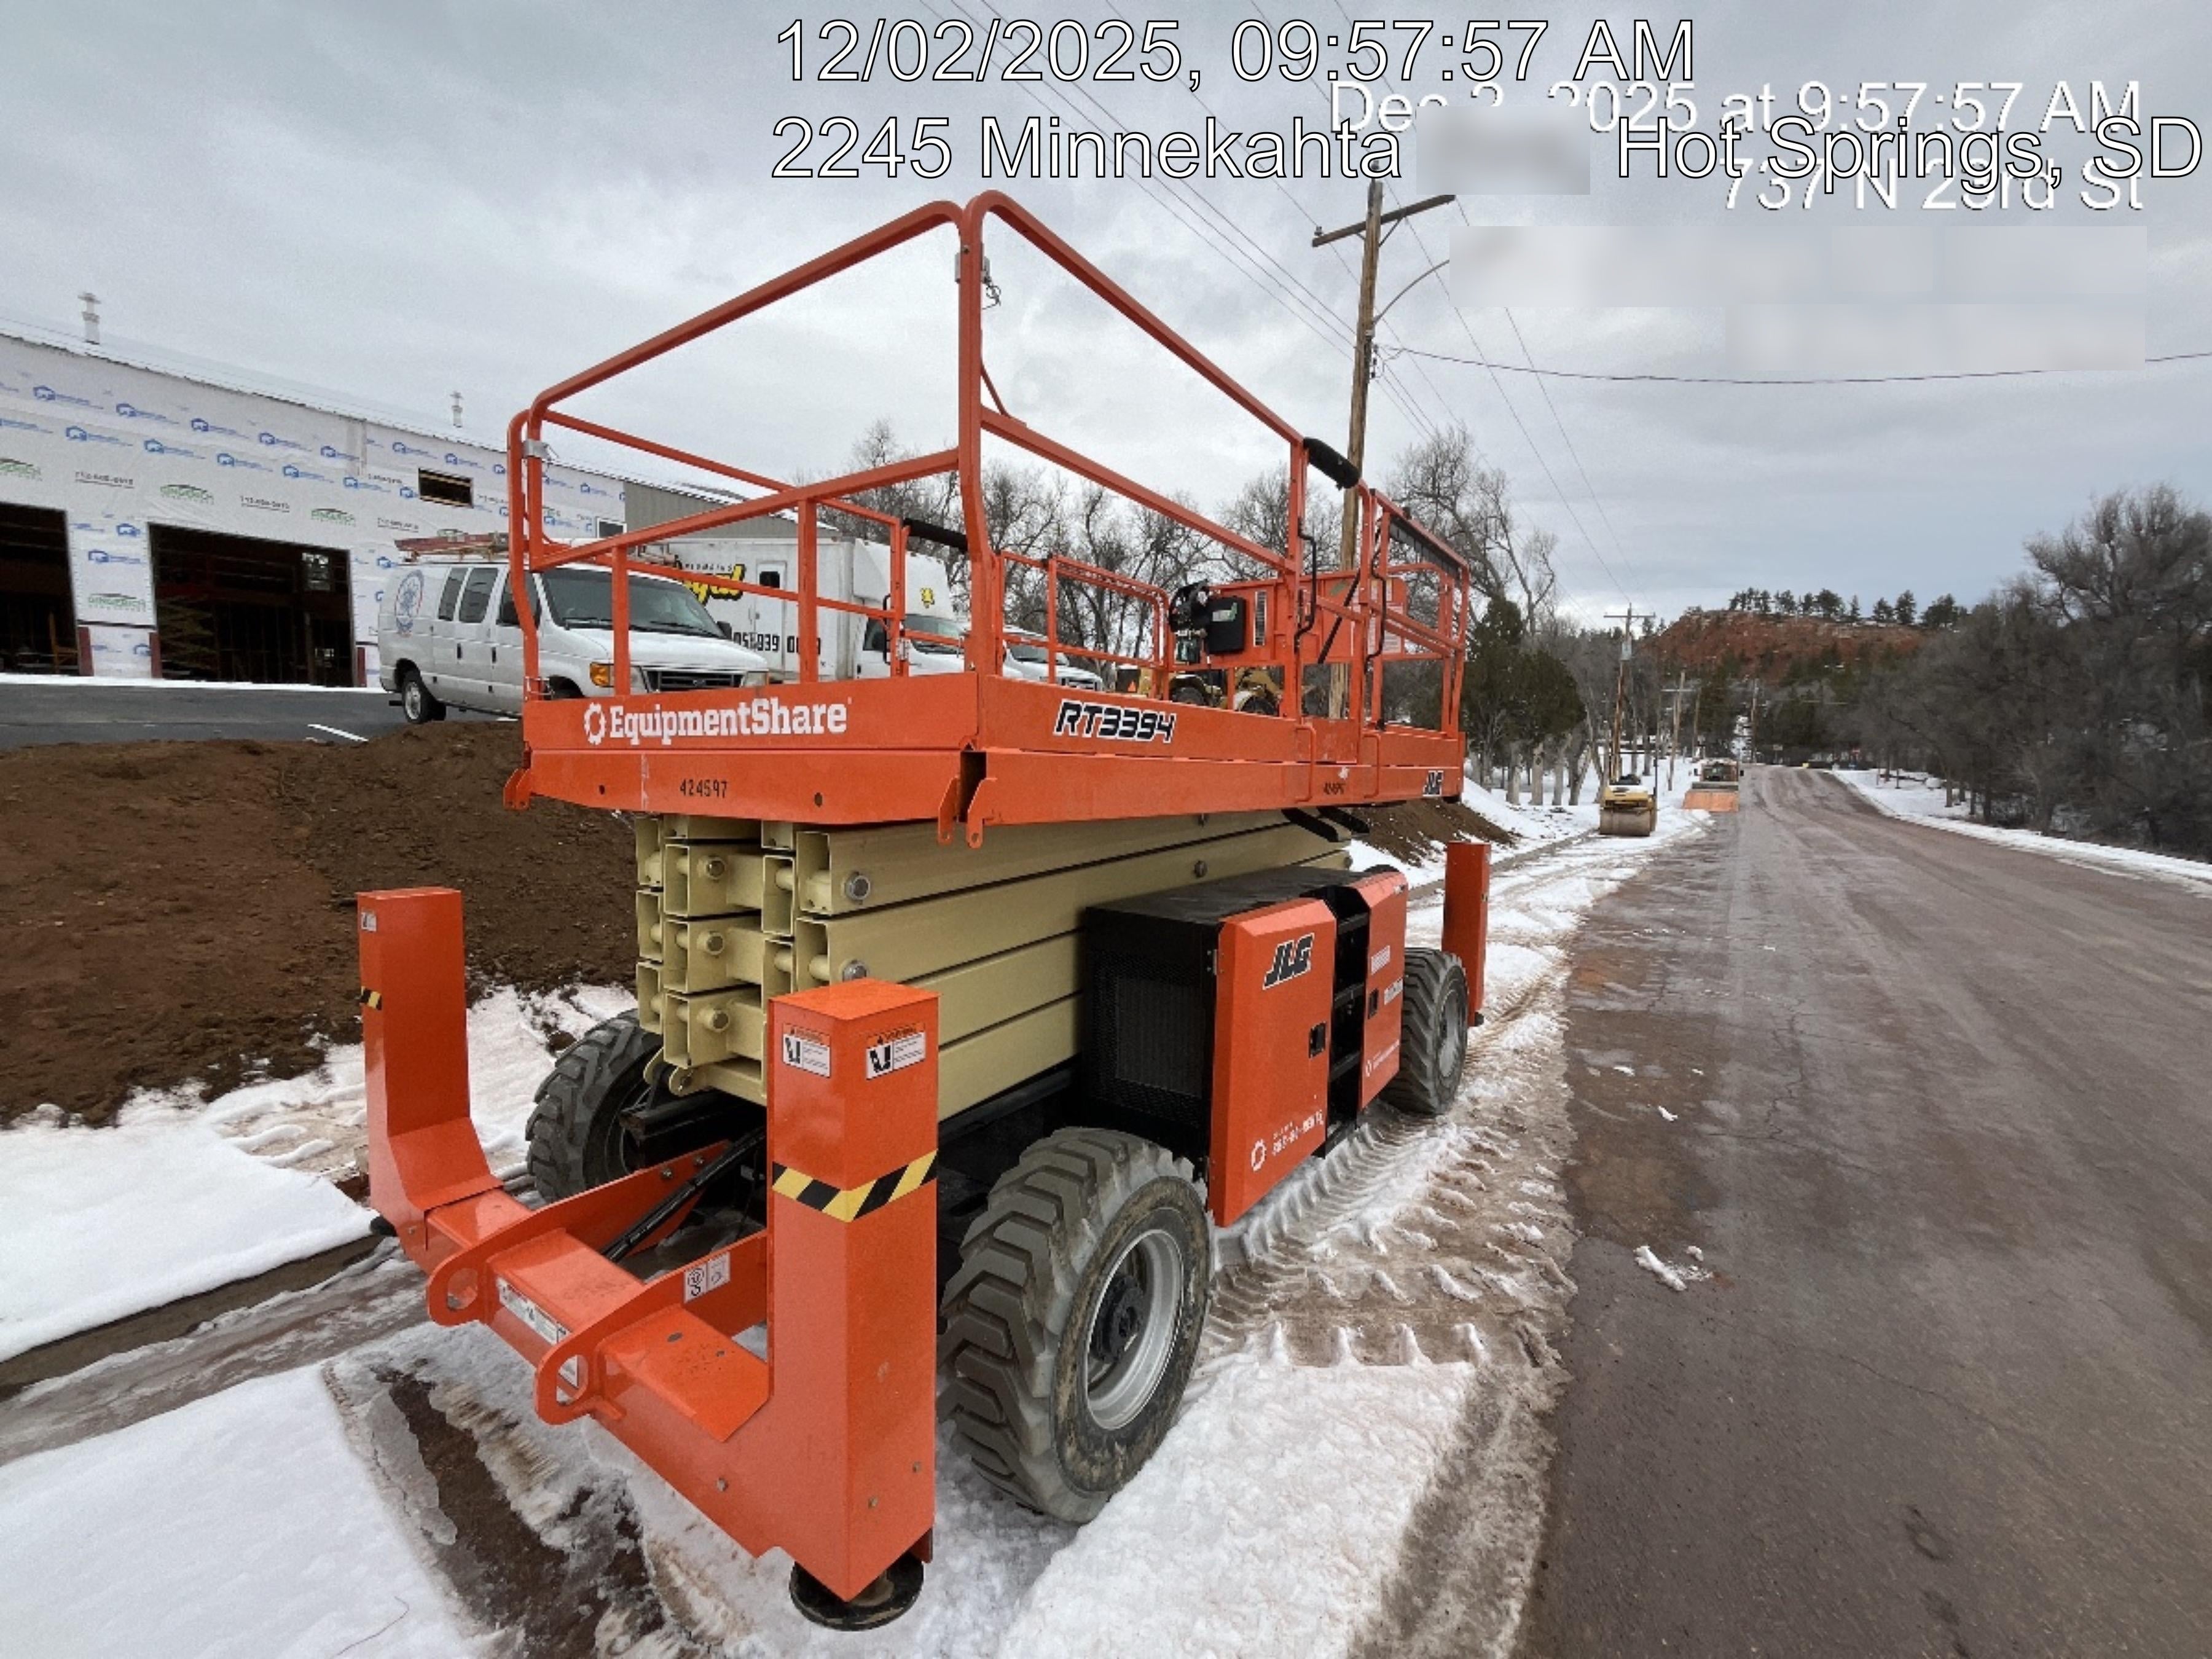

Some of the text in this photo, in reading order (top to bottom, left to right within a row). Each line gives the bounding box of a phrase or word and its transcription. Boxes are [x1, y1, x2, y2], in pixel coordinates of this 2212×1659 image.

[757, 634, 780, 651] 939
[609, 697, 847, 746] EquipmentShare
[1053, 699, 1177, 743] RT3394
[679, 778, 728, 798] 424597
[1262, 932, 1315, 990] JLG
